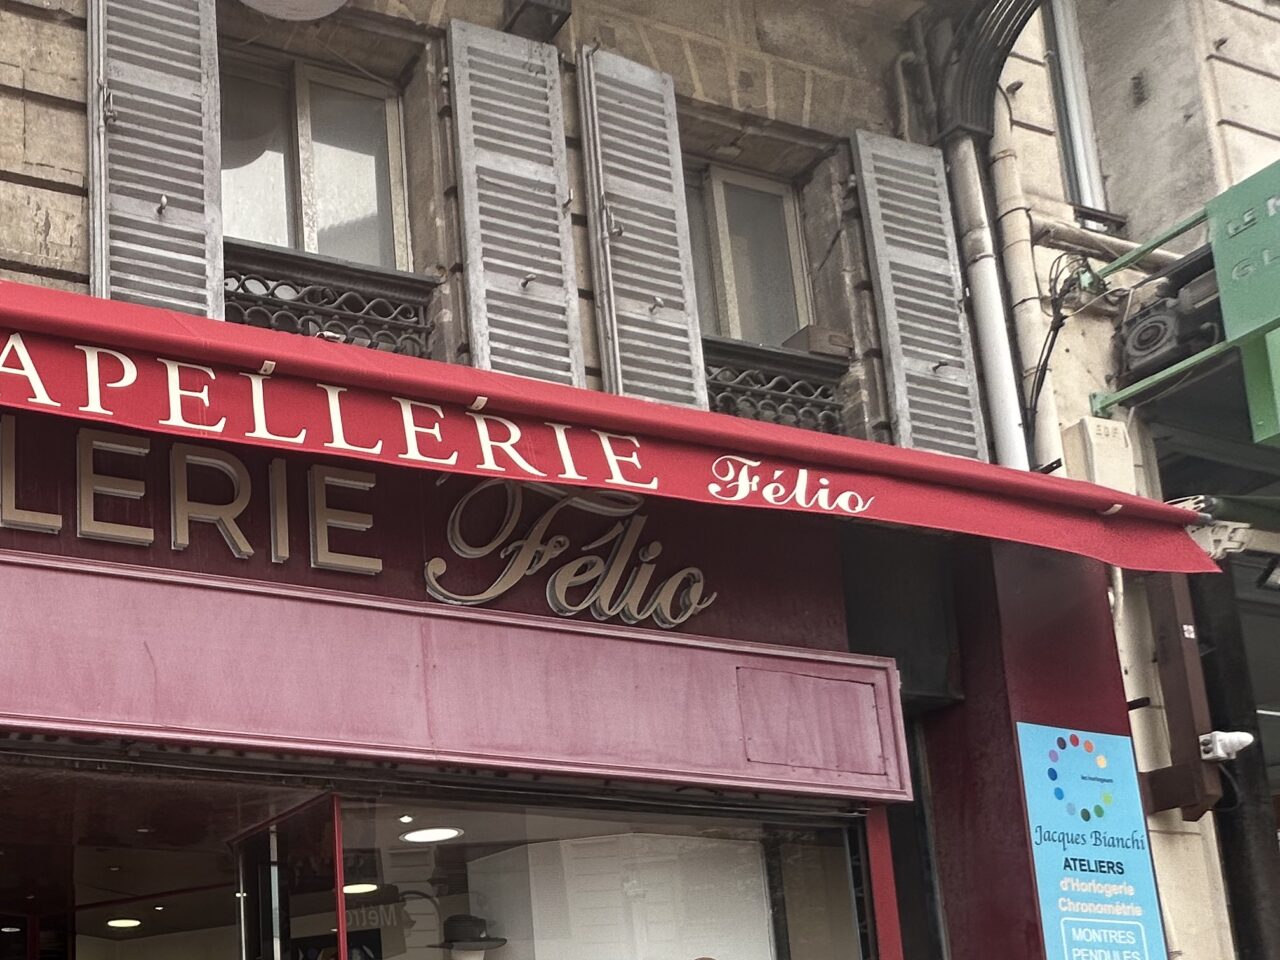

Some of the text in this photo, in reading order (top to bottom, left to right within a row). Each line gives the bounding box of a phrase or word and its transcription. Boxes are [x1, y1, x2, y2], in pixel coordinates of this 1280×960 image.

[707, 454, 875, 514] Félio
[424, 474, 718, 629] Félio
[1034, 825, 1145, 851] Jacques Bianchi
[1063, 857, 1125, 875] ATELIERS
[1060, 877, 1135, 897] d'Horlogerie
[1058, 897, 1143, 916] Chronométrie
[1071, 927, 1136, 944] MONTRES
